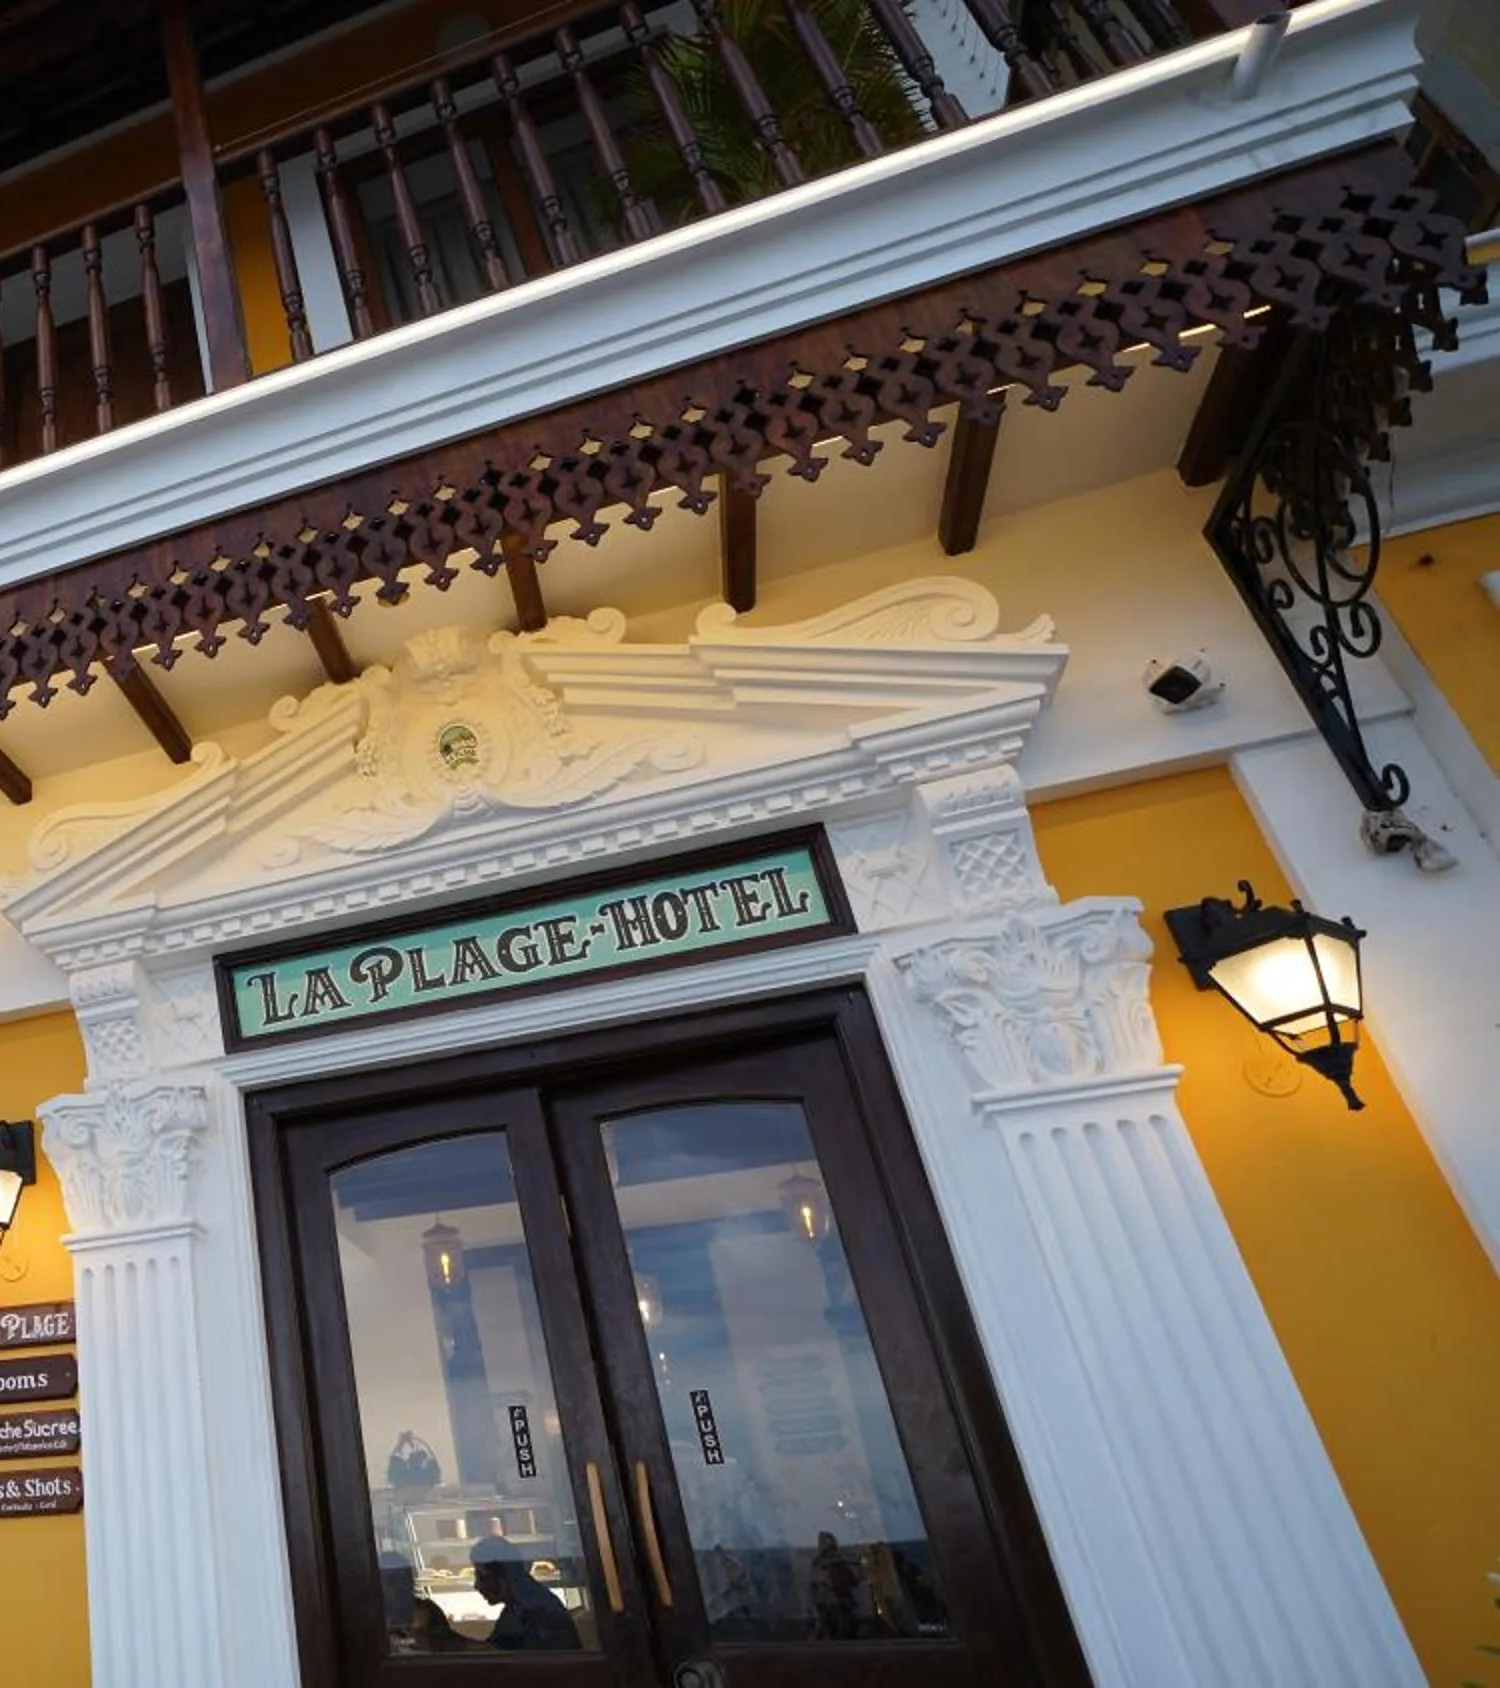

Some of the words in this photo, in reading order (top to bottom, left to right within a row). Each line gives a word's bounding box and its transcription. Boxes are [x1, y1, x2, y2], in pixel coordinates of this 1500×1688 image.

[247, 964, 350, 1028] LA
[1, 1311, 71, 1341] PLAGE
[513, 1418, 535, 1477] PUSH
[696, 1404, 722, 1464] PUSH
[6, 1479, 21, 1499] &
[25, 1477, 72, 1498] Shots
